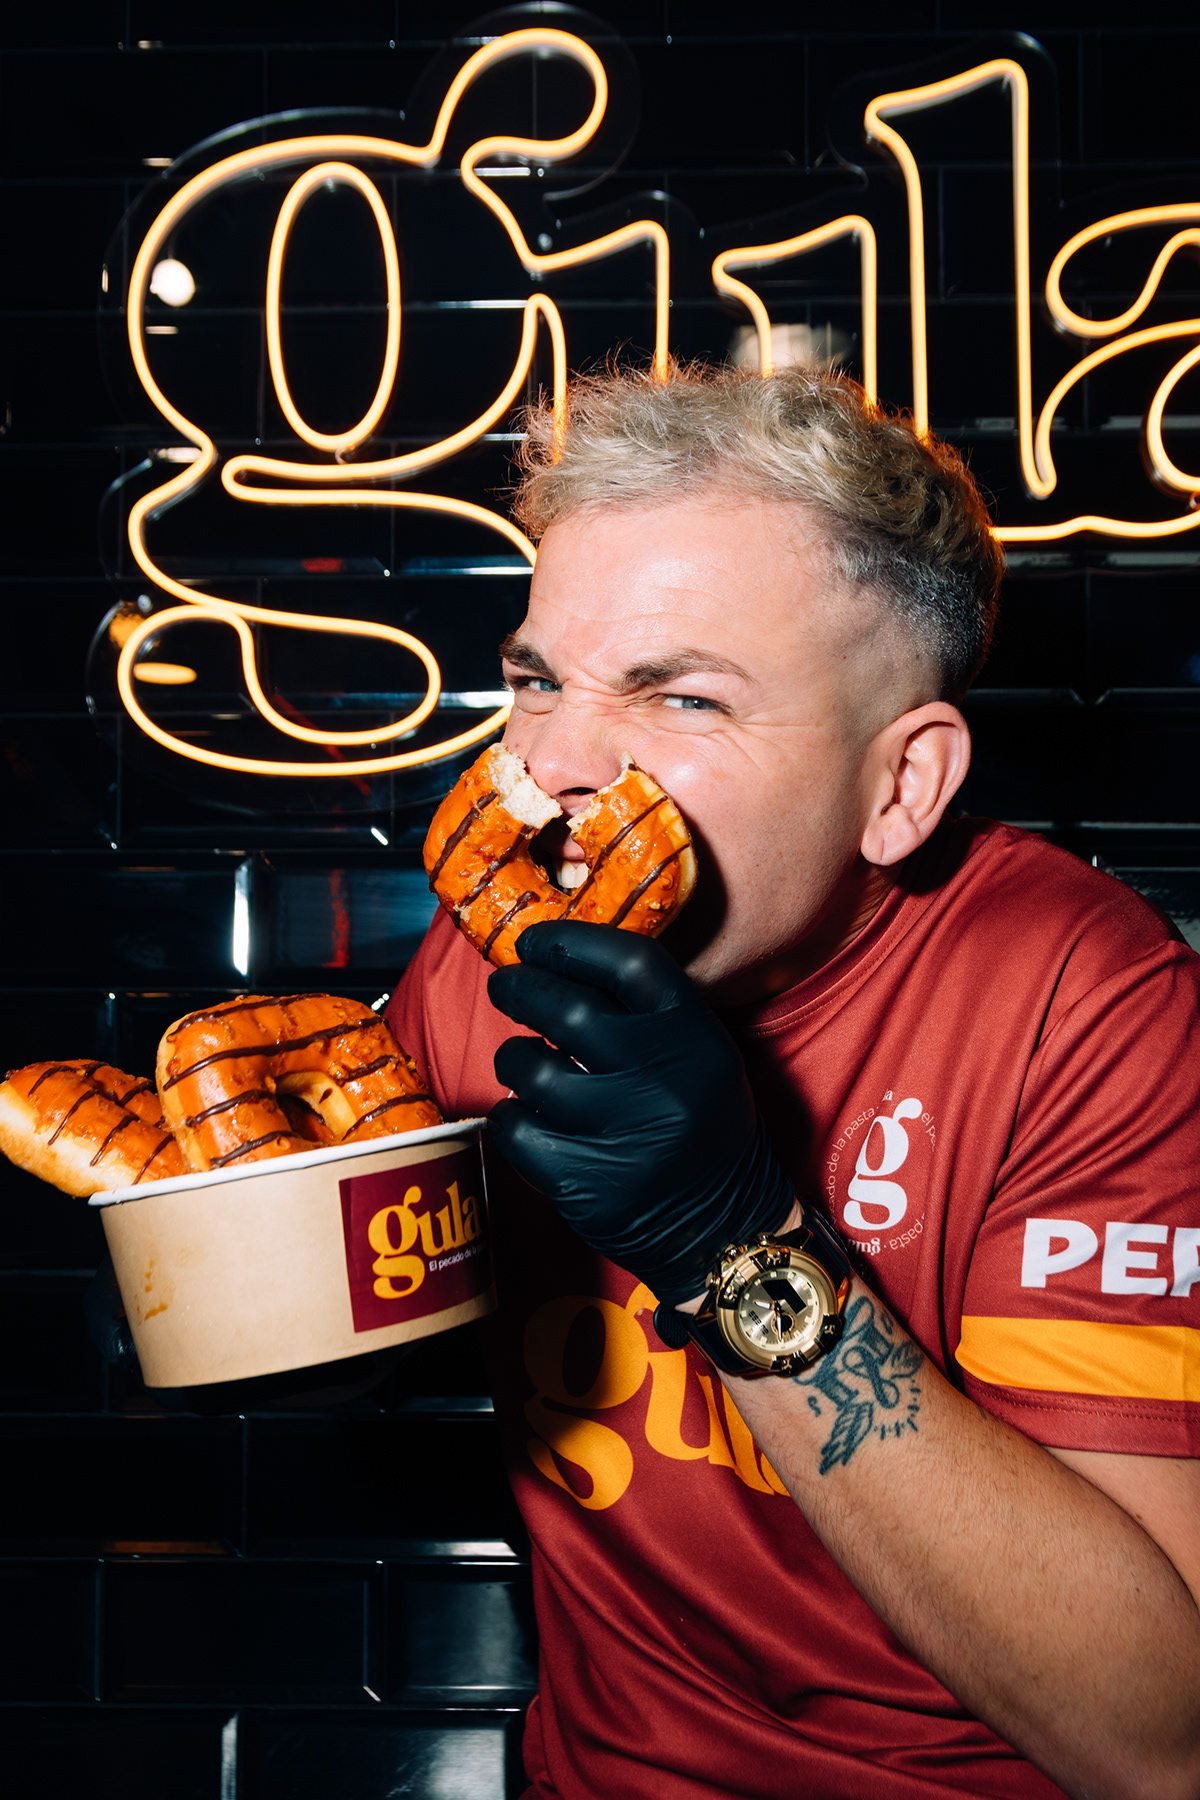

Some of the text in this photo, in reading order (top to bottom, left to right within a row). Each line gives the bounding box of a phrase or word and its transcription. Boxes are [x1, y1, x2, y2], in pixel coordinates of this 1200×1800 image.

[844, 1107, 875, 1140] pasta
[832, 1138, 846, 1151] la
[826, 1152, 840, 1173] de
[843, 1097, 924, 1231] g
[367, 1180, 480, 1299] gula
[889, 1220, 924, 1250] pasta
